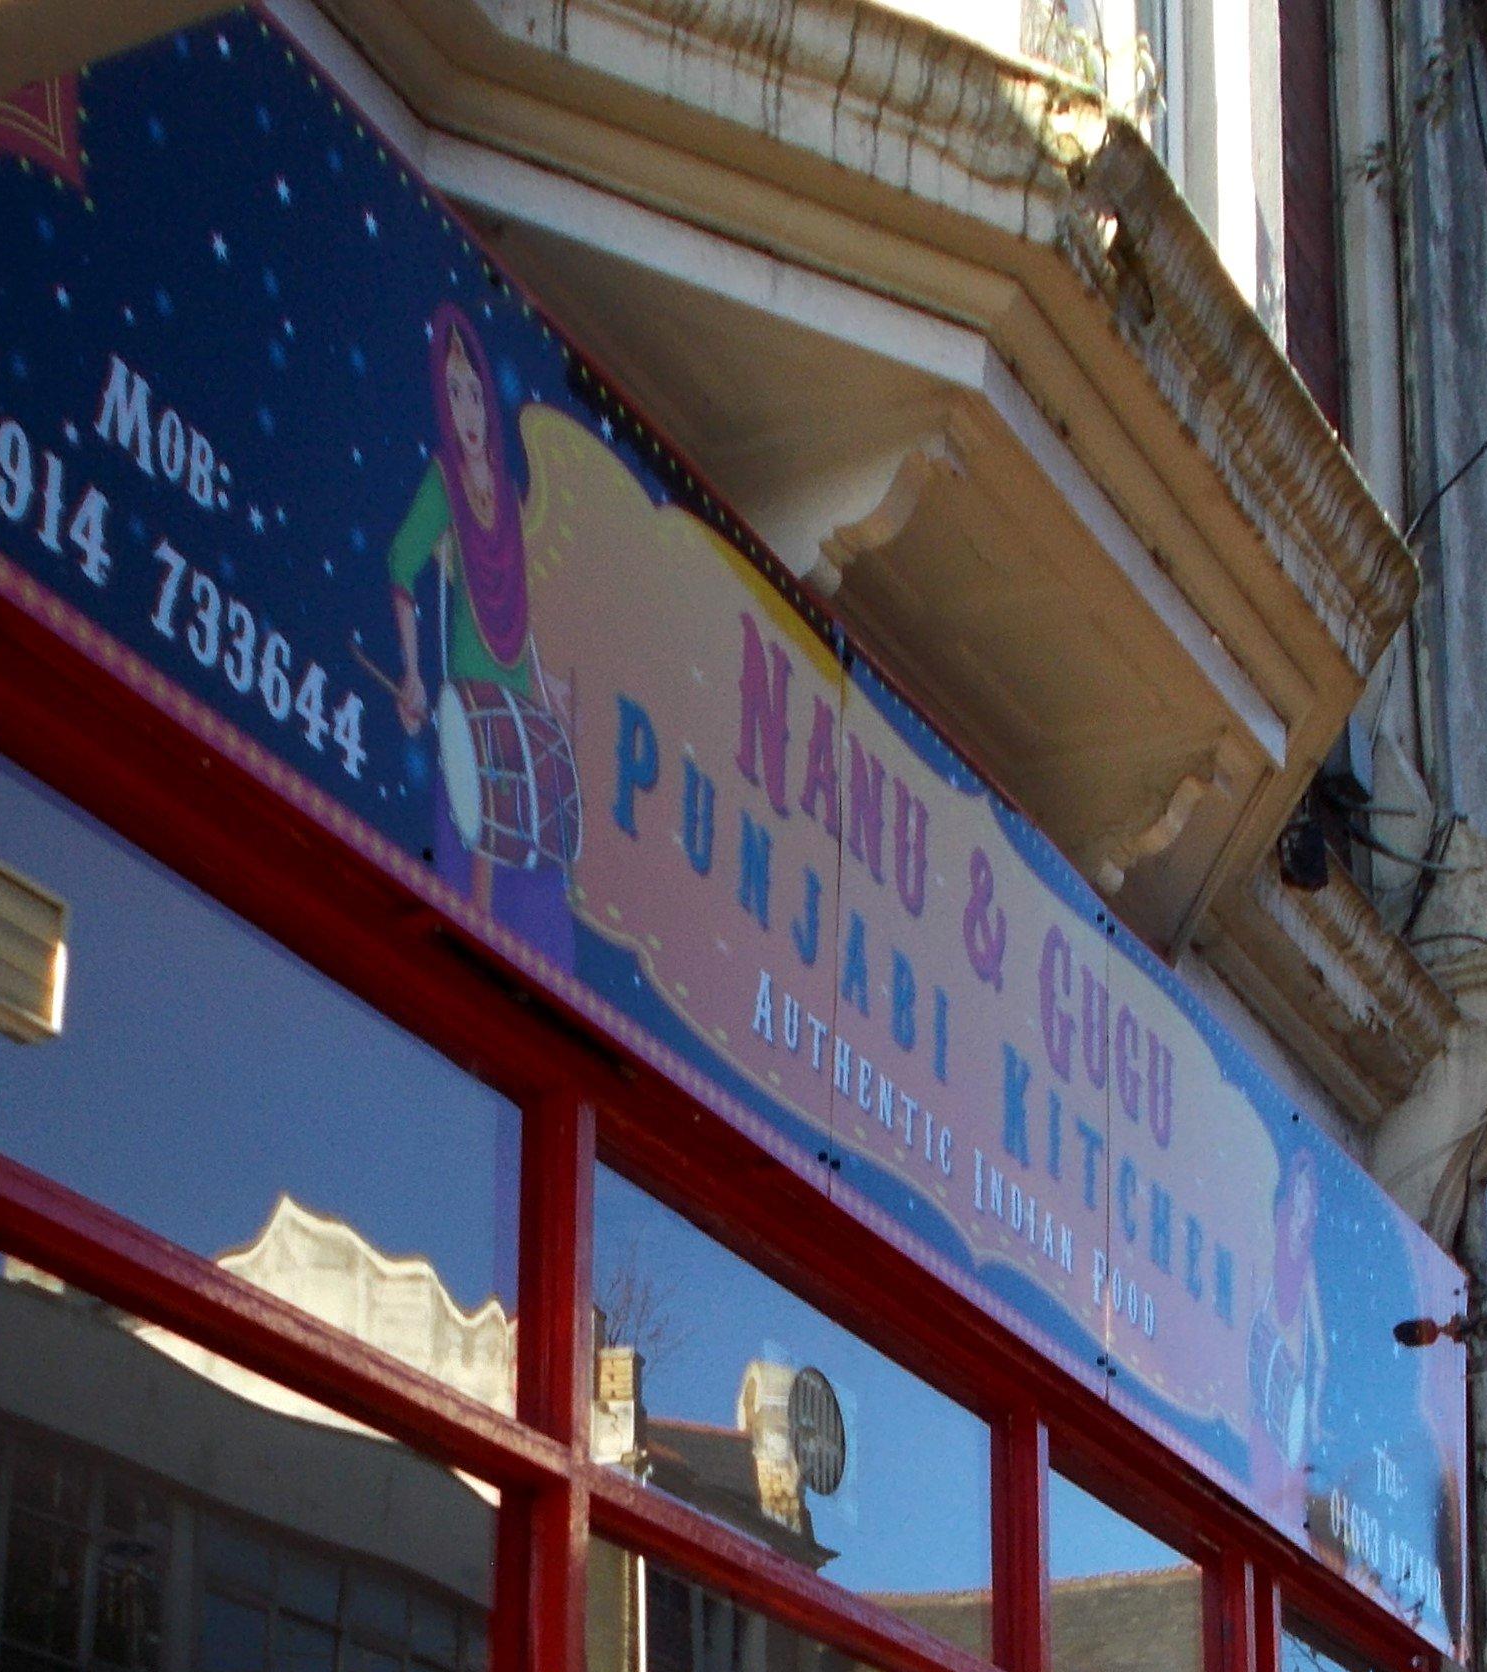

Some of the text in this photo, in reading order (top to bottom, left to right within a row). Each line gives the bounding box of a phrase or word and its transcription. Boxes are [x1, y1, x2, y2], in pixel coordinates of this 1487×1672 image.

[152, 537, 369, 780] 733644
[736, 610, 1176, 1150] NANU & GUGU
[612, 692, 1239, 1327] PUNJABI KITCHEN
[750, 968, 1158, 1341] AUTHENTIC INDIAN FOOD
